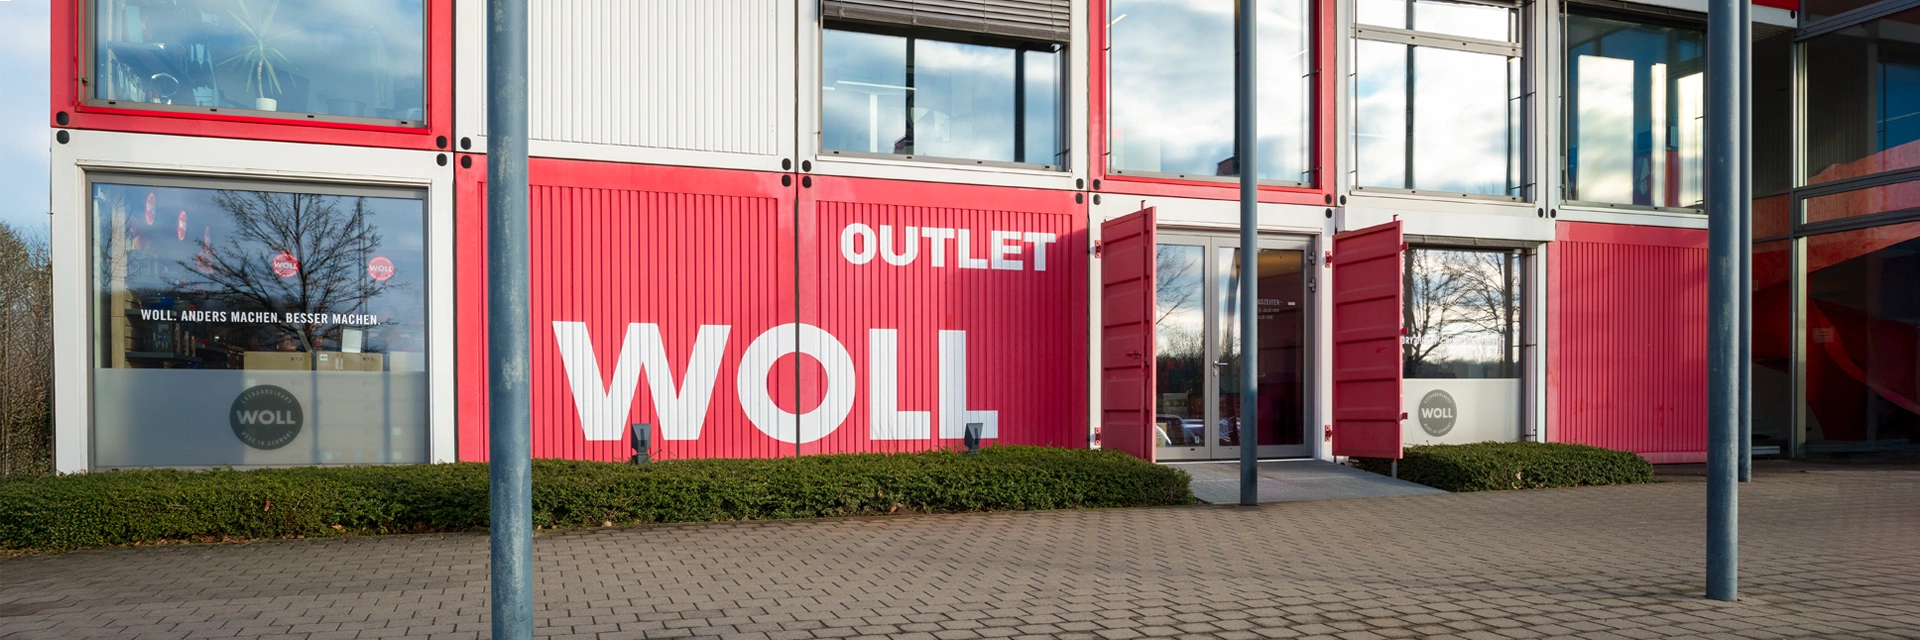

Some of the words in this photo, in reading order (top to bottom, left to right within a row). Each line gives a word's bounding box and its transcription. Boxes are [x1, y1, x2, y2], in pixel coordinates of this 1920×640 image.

[840, 223, 1057, 271] OUTLET
[274, 261, 298, 269] WOLL
[369, 264, 393, 272] WOLL
[140, 309, 177, 321] WOLL.
[181, 310, 227, 322] ANDERS
[231, 311, 282, 323] MACHEN.
[285, 312, 328, 324] BESSER
[332, 313, 381, 325] MACHEN.
[551, 321, 998, 444] WOLL
[236, 409, 296, 425] WOLL
[1421, 407, 1454, 419] WOLL
